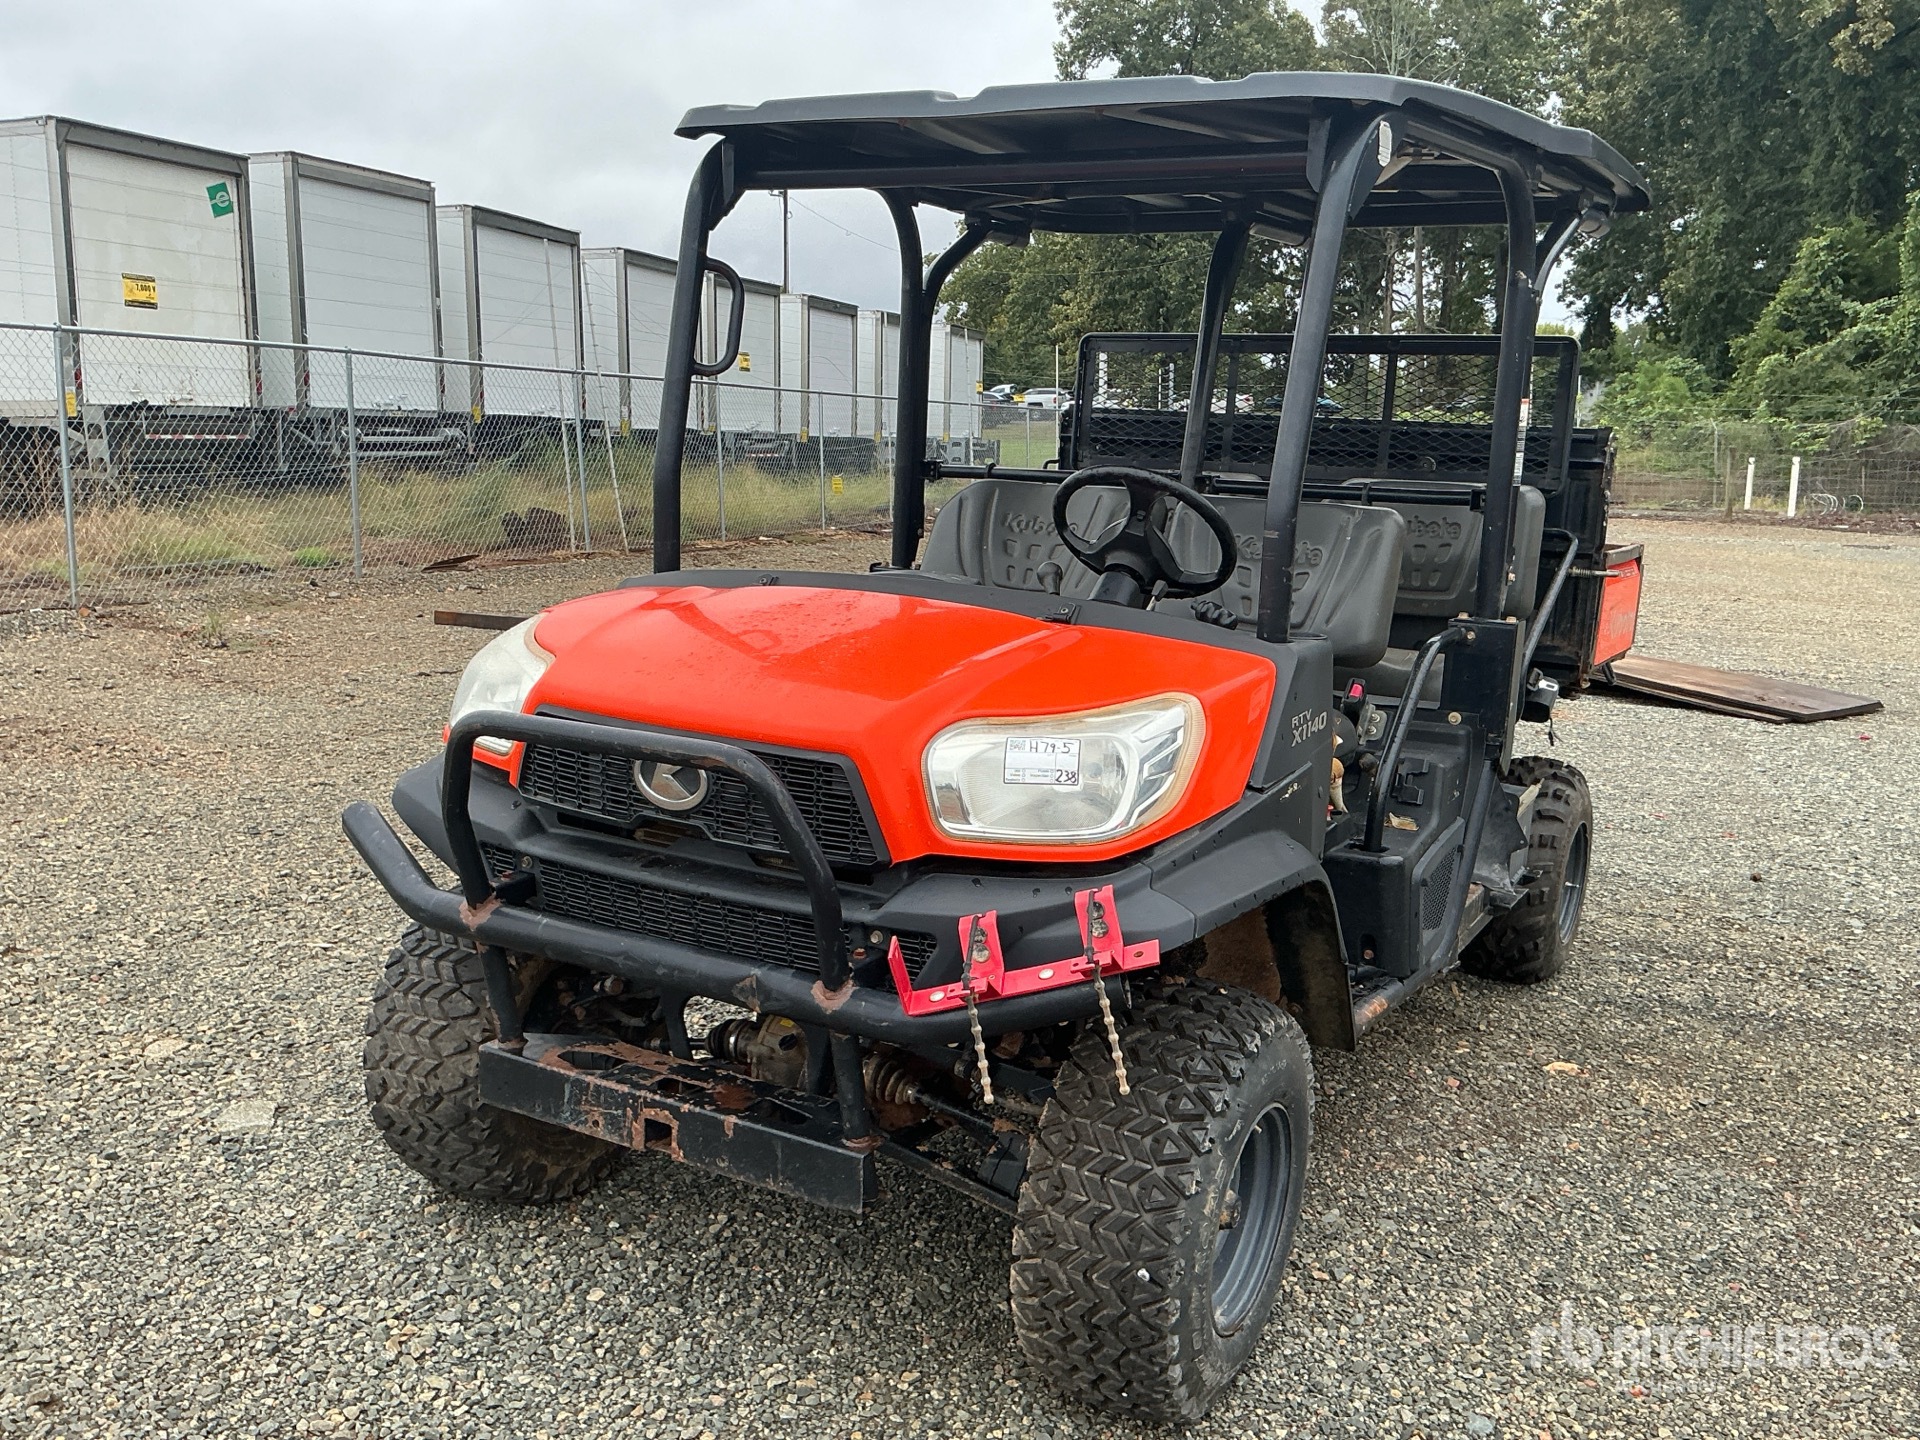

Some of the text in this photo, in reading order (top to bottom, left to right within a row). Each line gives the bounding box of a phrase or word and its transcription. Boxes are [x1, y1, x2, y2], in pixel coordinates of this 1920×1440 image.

[1291, 708, 1312, 729] RTV
[1291, 711, 1328, 748] X1140
[1055, 768, 1077, 783] 238
